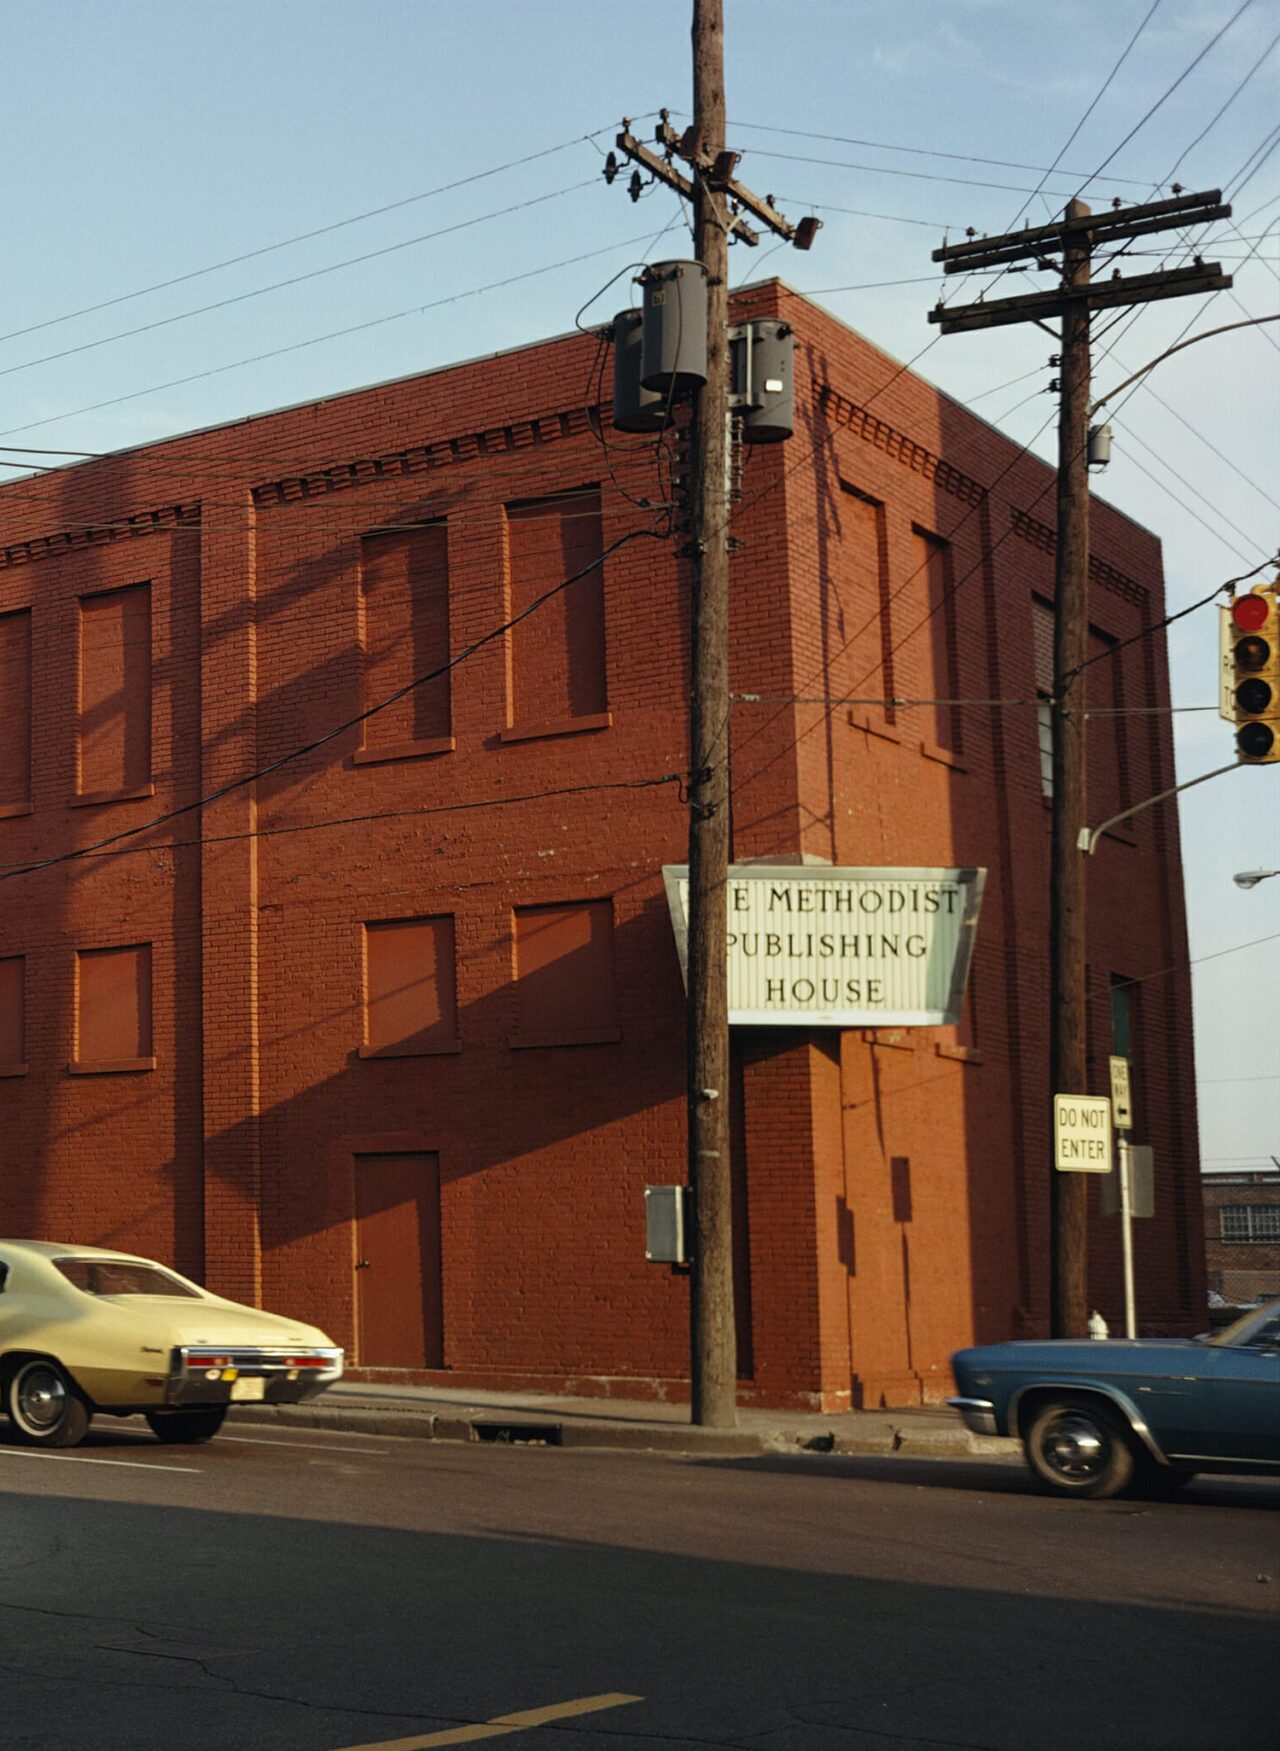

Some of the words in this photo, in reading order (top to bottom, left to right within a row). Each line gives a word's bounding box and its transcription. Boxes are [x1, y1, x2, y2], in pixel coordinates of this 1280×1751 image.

[768, 888, 959, 914] METHODIST
[766, 978, 884, 1003] HOUSE
[1060, 1107, 1077, 1127] DO
[1081, 1109, 1106, 1129] NOT
[1061, 1138, 1105, 1160] ENTER
